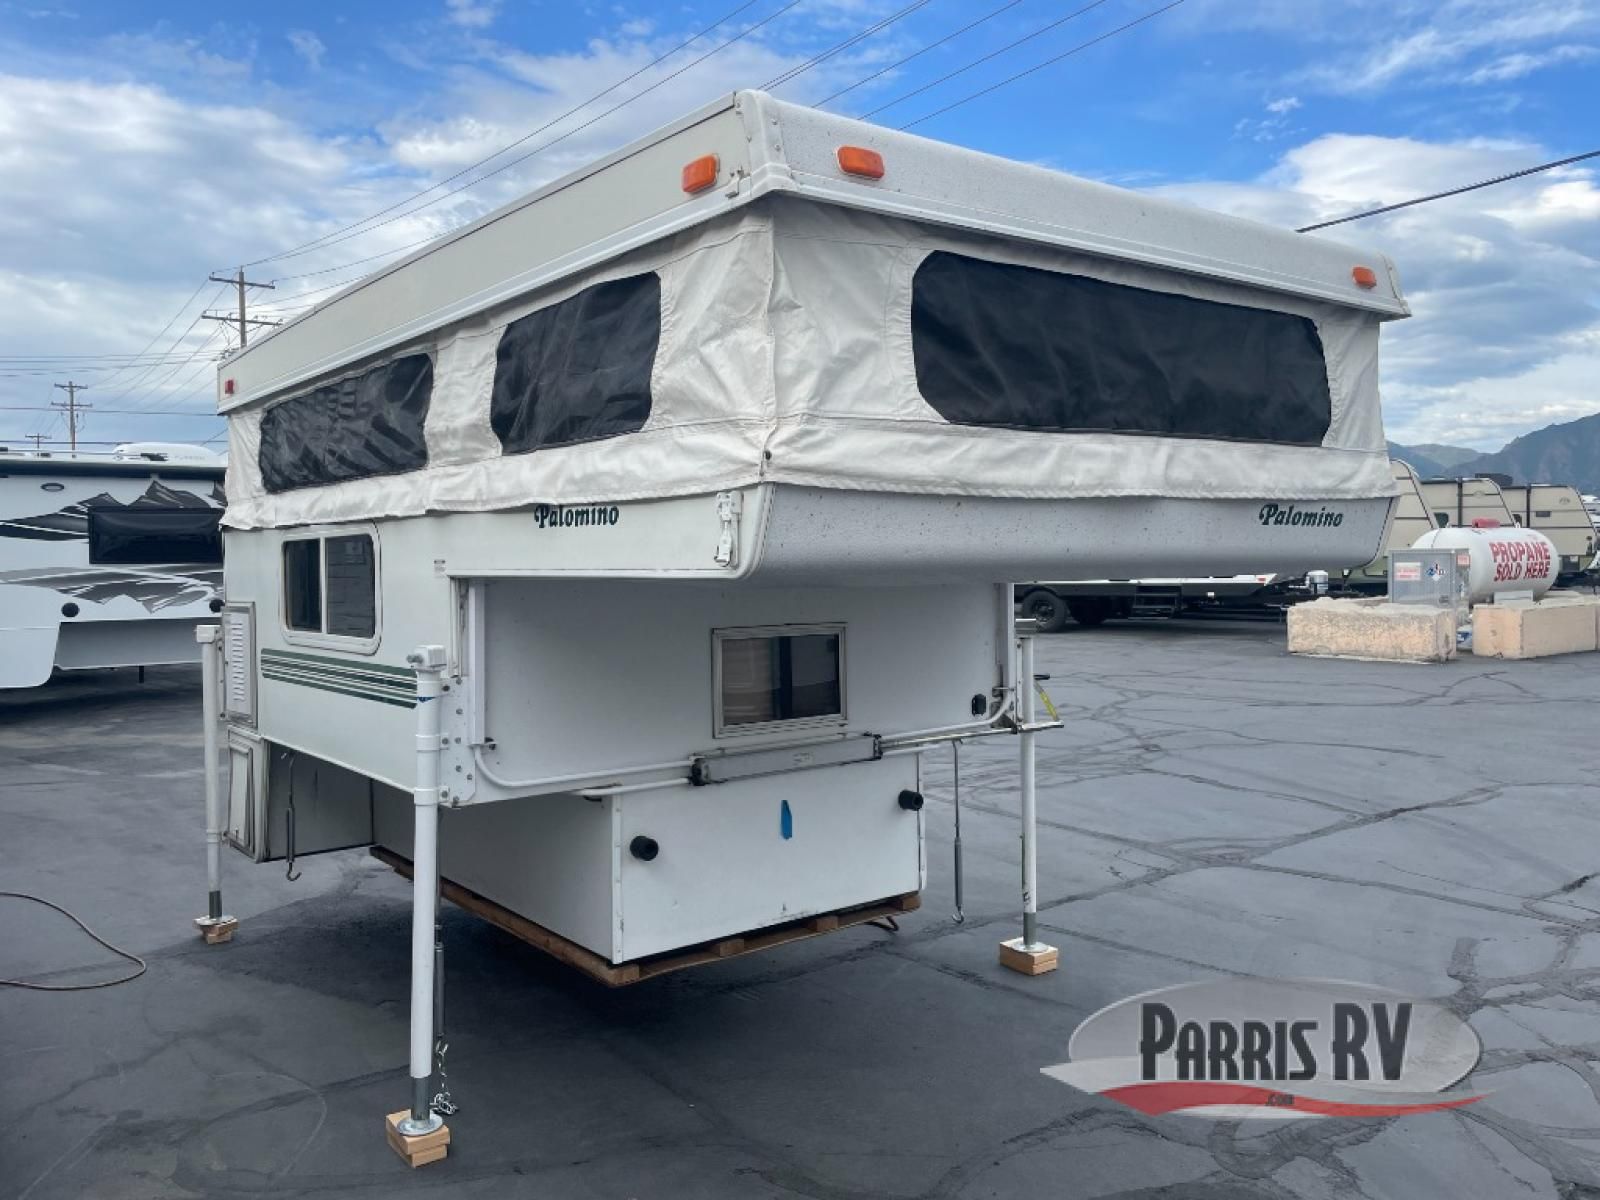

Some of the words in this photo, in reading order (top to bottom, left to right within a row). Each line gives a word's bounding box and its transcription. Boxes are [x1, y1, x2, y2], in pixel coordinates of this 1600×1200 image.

[534, 503, 620, 529] Palomino
[1259, 502, 1344, 528] Palomino
[1488, 541, 1551, 563] PROPANE
[1493, 562, 1522, 582] SOLD
[1523, 560, 1551, 579] HERE
